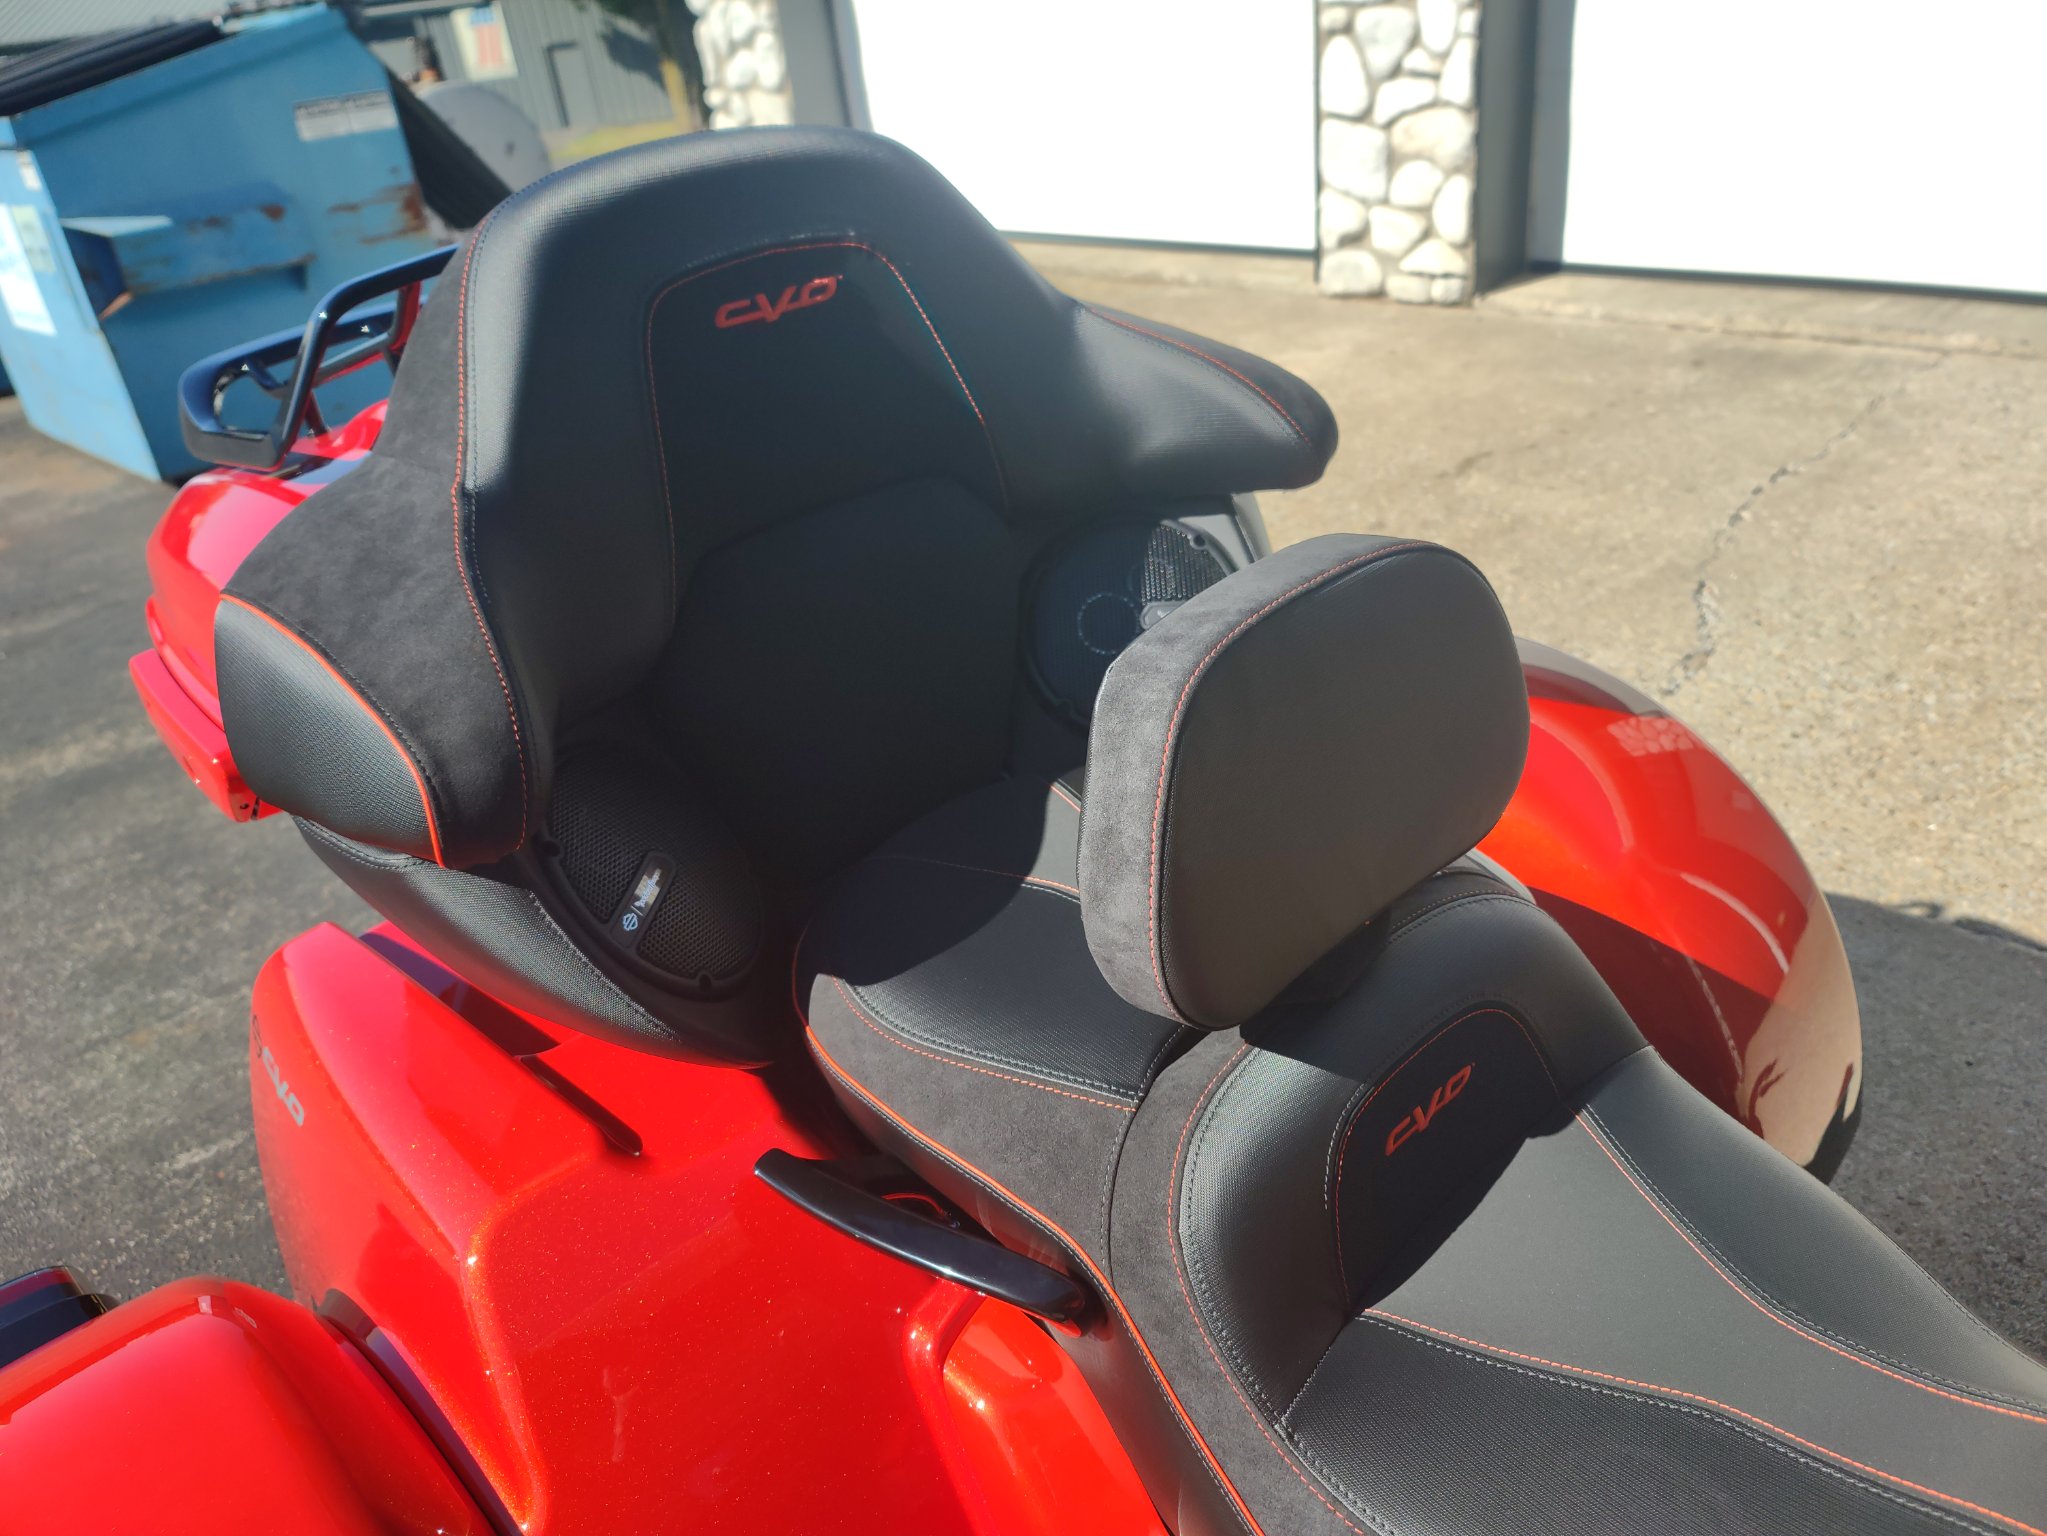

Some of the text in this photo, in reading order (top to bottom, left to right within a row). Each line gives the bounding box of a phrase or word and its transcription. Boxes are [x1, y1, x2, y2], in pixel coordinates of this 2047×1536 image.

[715, 275, 838, 328] CVO
[262, 1046, 305, 1127] CVO
[1385, 1064, 1473, 1156] CVO
